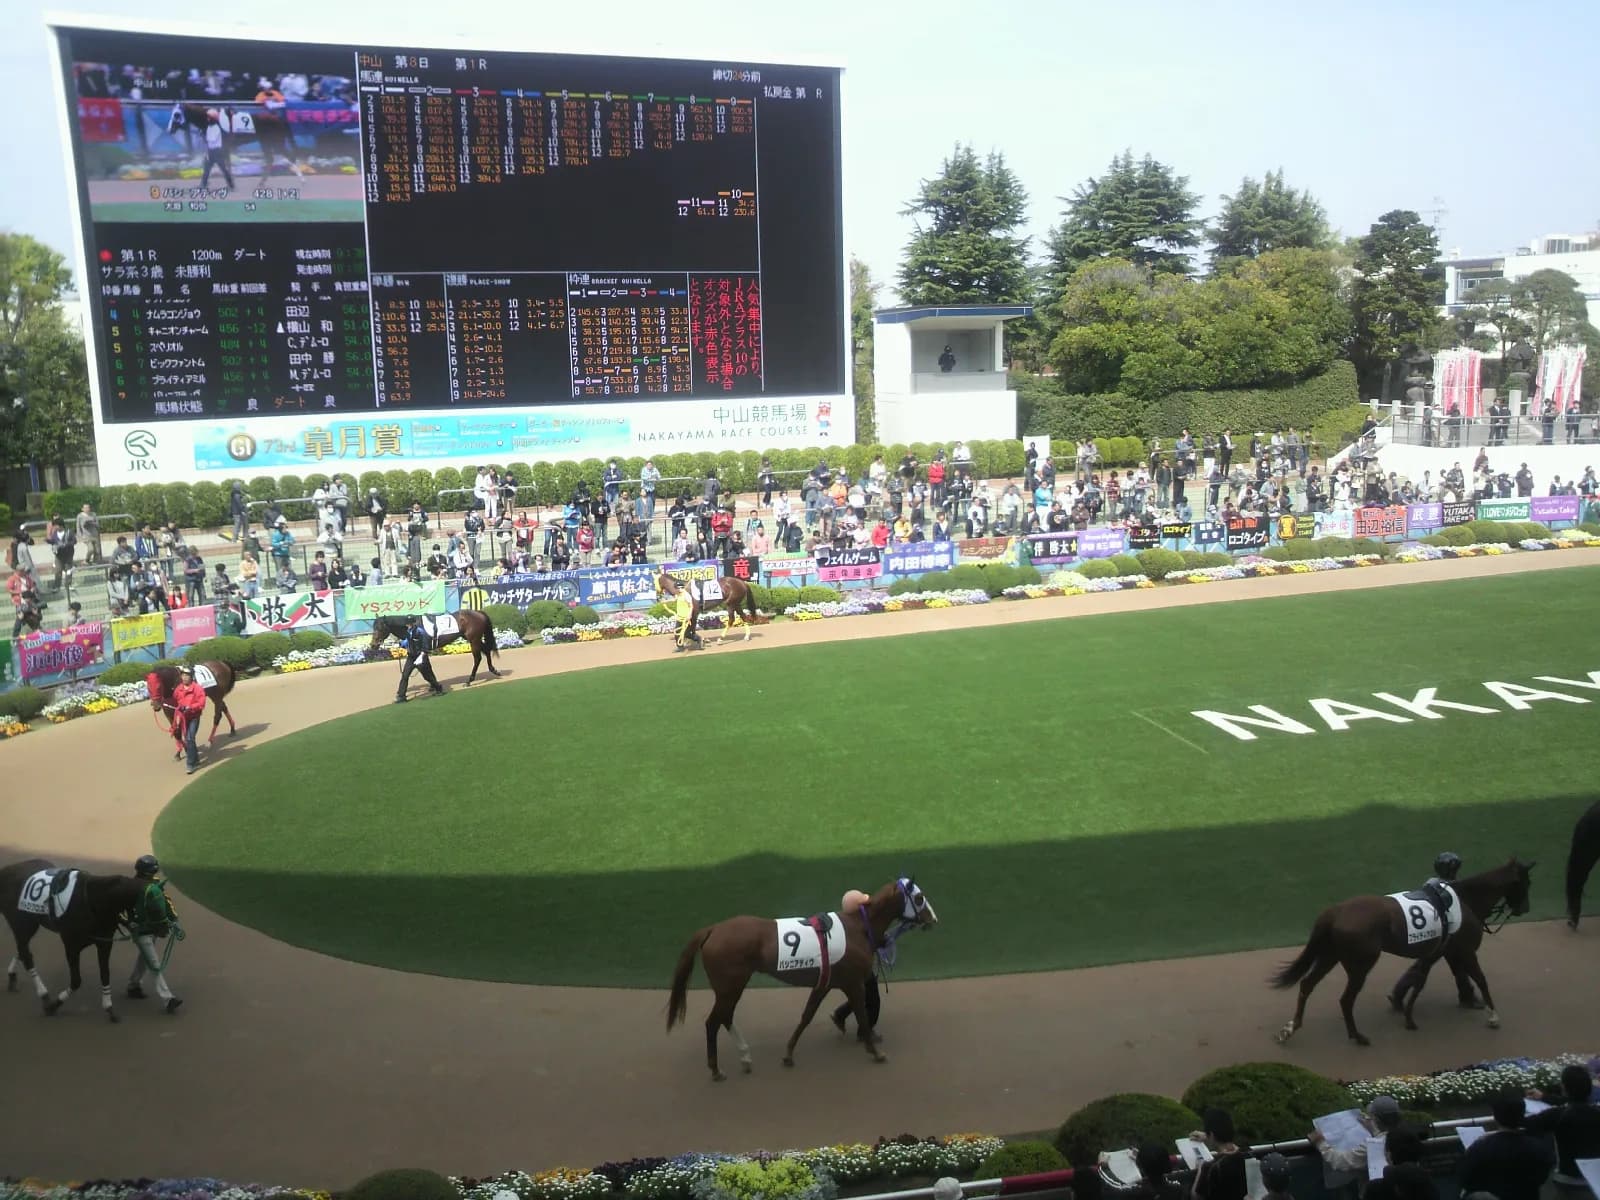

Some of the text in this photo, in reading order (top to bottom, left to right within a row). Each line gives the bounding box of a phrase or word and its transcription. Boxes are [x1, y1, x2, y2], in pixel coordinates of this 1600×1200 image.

[359, 54, 382, 67] 中山
[395, 55, 429, 69] 第8日
[380, 85, 737, 106] 1 2 3 4 5 6 7 8 9
[816, 87, 823, 98] R
[242, 117, 249, 127] 9
[413, 164, 424, 173] 10
[731, 189, 742, 199] 10
[691, 198, 701, 207] 11
[718, 199, 728, 208] 11
[678, 207, 688, 216] 12
[719, 208, 729, 217] 12
[192, 250, 222, 260] 1200m
[234, 248, 266, 260] ダート
[102, 264, 211, 279] サラ系3歳 未勝利
[374, 301, 379, 309] 1
[409, 300, 420, 309] 10
[374, 311, 380, 321] 2
[410, 311, 420, 321] 11
[112, 326, 120, 337] 5
[148, 325, 208, 336] キャニオンチャーム
[320, 320, 333, 332] 和
[375, 323, 381, 333] 3
[410, 323, 421, 333] 12
[703, 278, 719, 384] オッズが赤色表示
[719, 278, 734, 390] 対象外となる場合
[376, 335, 382, 344] 4
[113, 342, 121, 354] 5
[376, 347, 383, 356] 5
[289, 352, 312, 365] 田中
[377, 358, 384, 367] 6
[378, 370, 384, 379] 7
[379, 382, 385, 390] 8
[380, 393, 386, 402] 9
[155, 400, 203, 415] 馬場状態
[713, 403, 807, 425] 中山競馬場
[638, 425, 808, 442] NAKAYAMA RACE COURSE
[303, 424, 404, 460] 皐月賞
[128, 460, 158, 472] JRA
[1443, 507, 1475, 516] YUTAKA
[1356, 518, 1403, 534] 田辺裕信
[1443, 516, 1461, 524] TAKE
[1228, 530, 1266, 545] ロゴタイプ
[733, 558, 750, 579] 竜
[708, 583, 720, 595] 12
[491, 586, 566, 605] タッチザターゲット
[24, 876, 47, 902] 10
[1409, 904, 1427, 930] 8
[783, 930, 801, 957] 9
